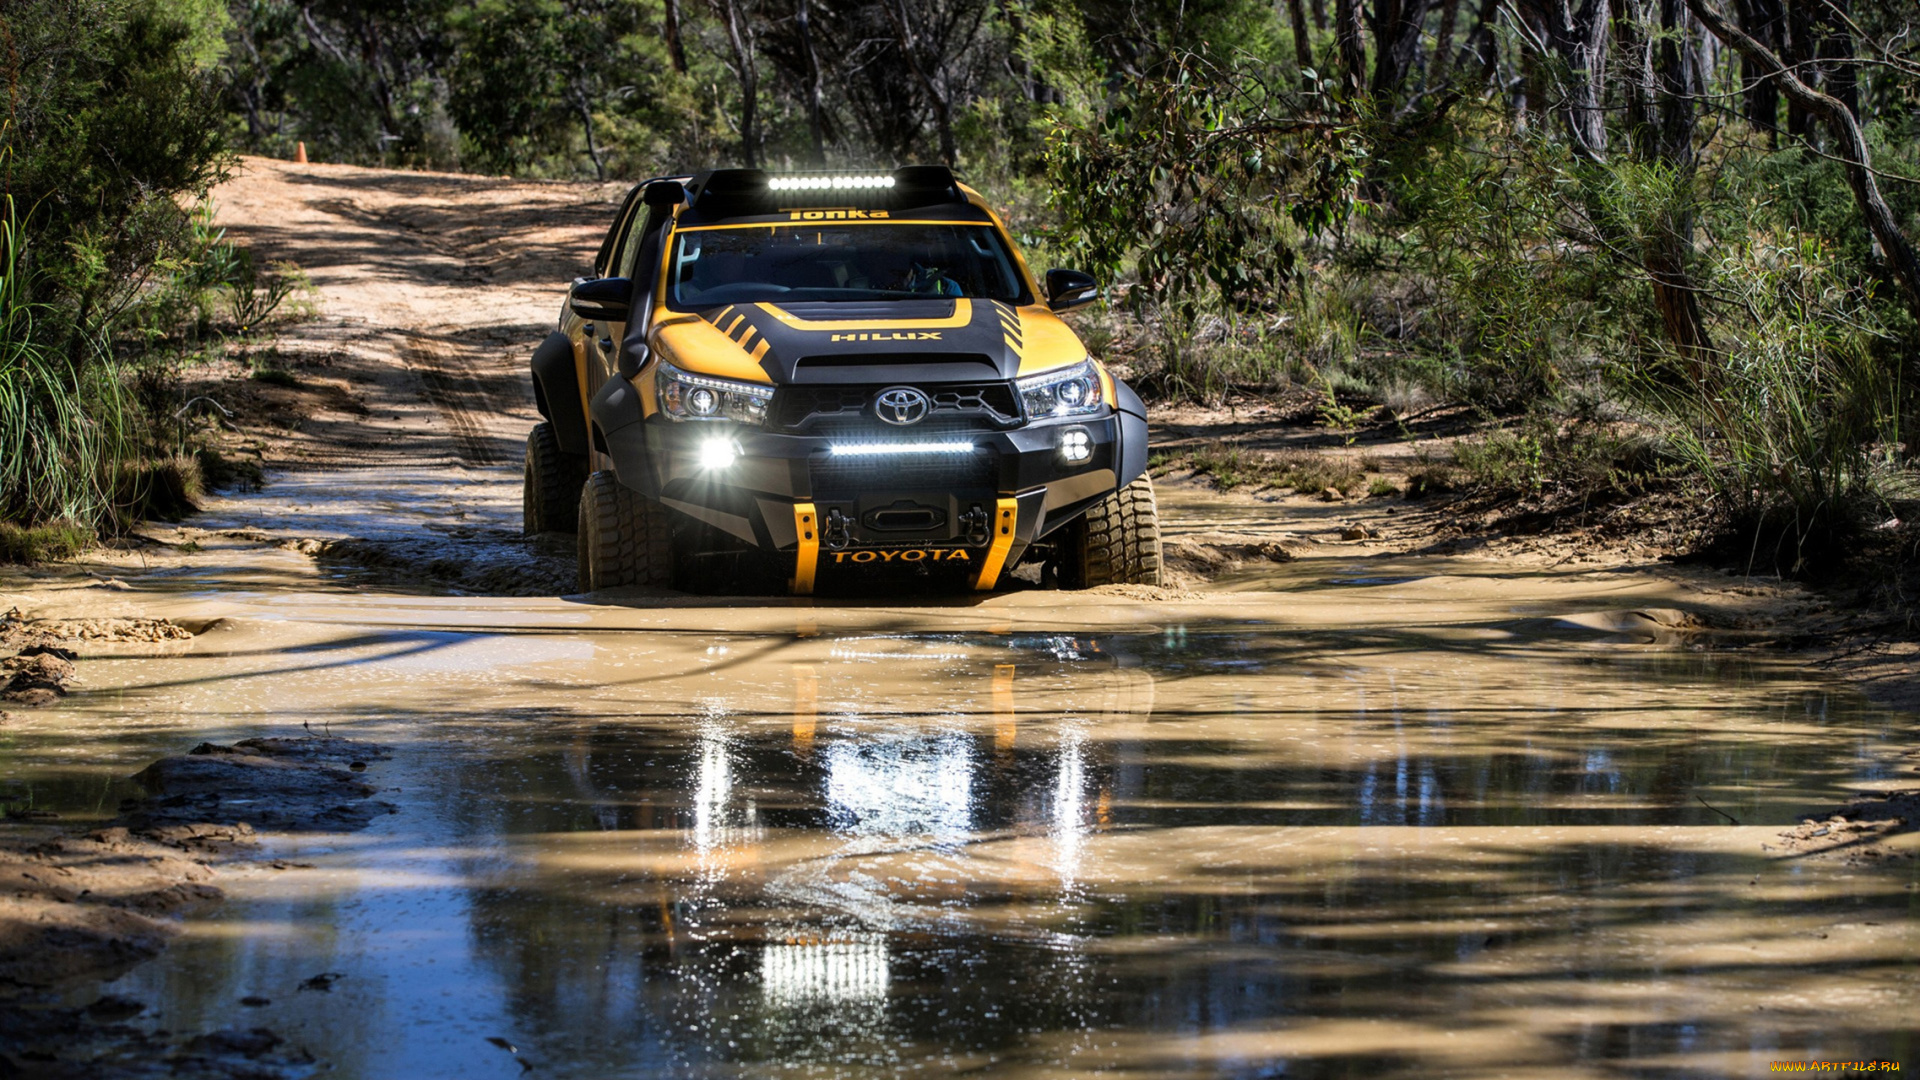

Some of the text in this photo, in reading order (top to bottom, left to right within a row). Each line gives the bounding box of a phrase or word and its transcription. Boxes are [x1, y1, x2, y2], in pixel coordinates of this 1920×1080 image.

[779, 207, 890, 220] Tonka
[831, 332, 942, 342] HILUX
[830, 549, 970, 563] TOYOTA
